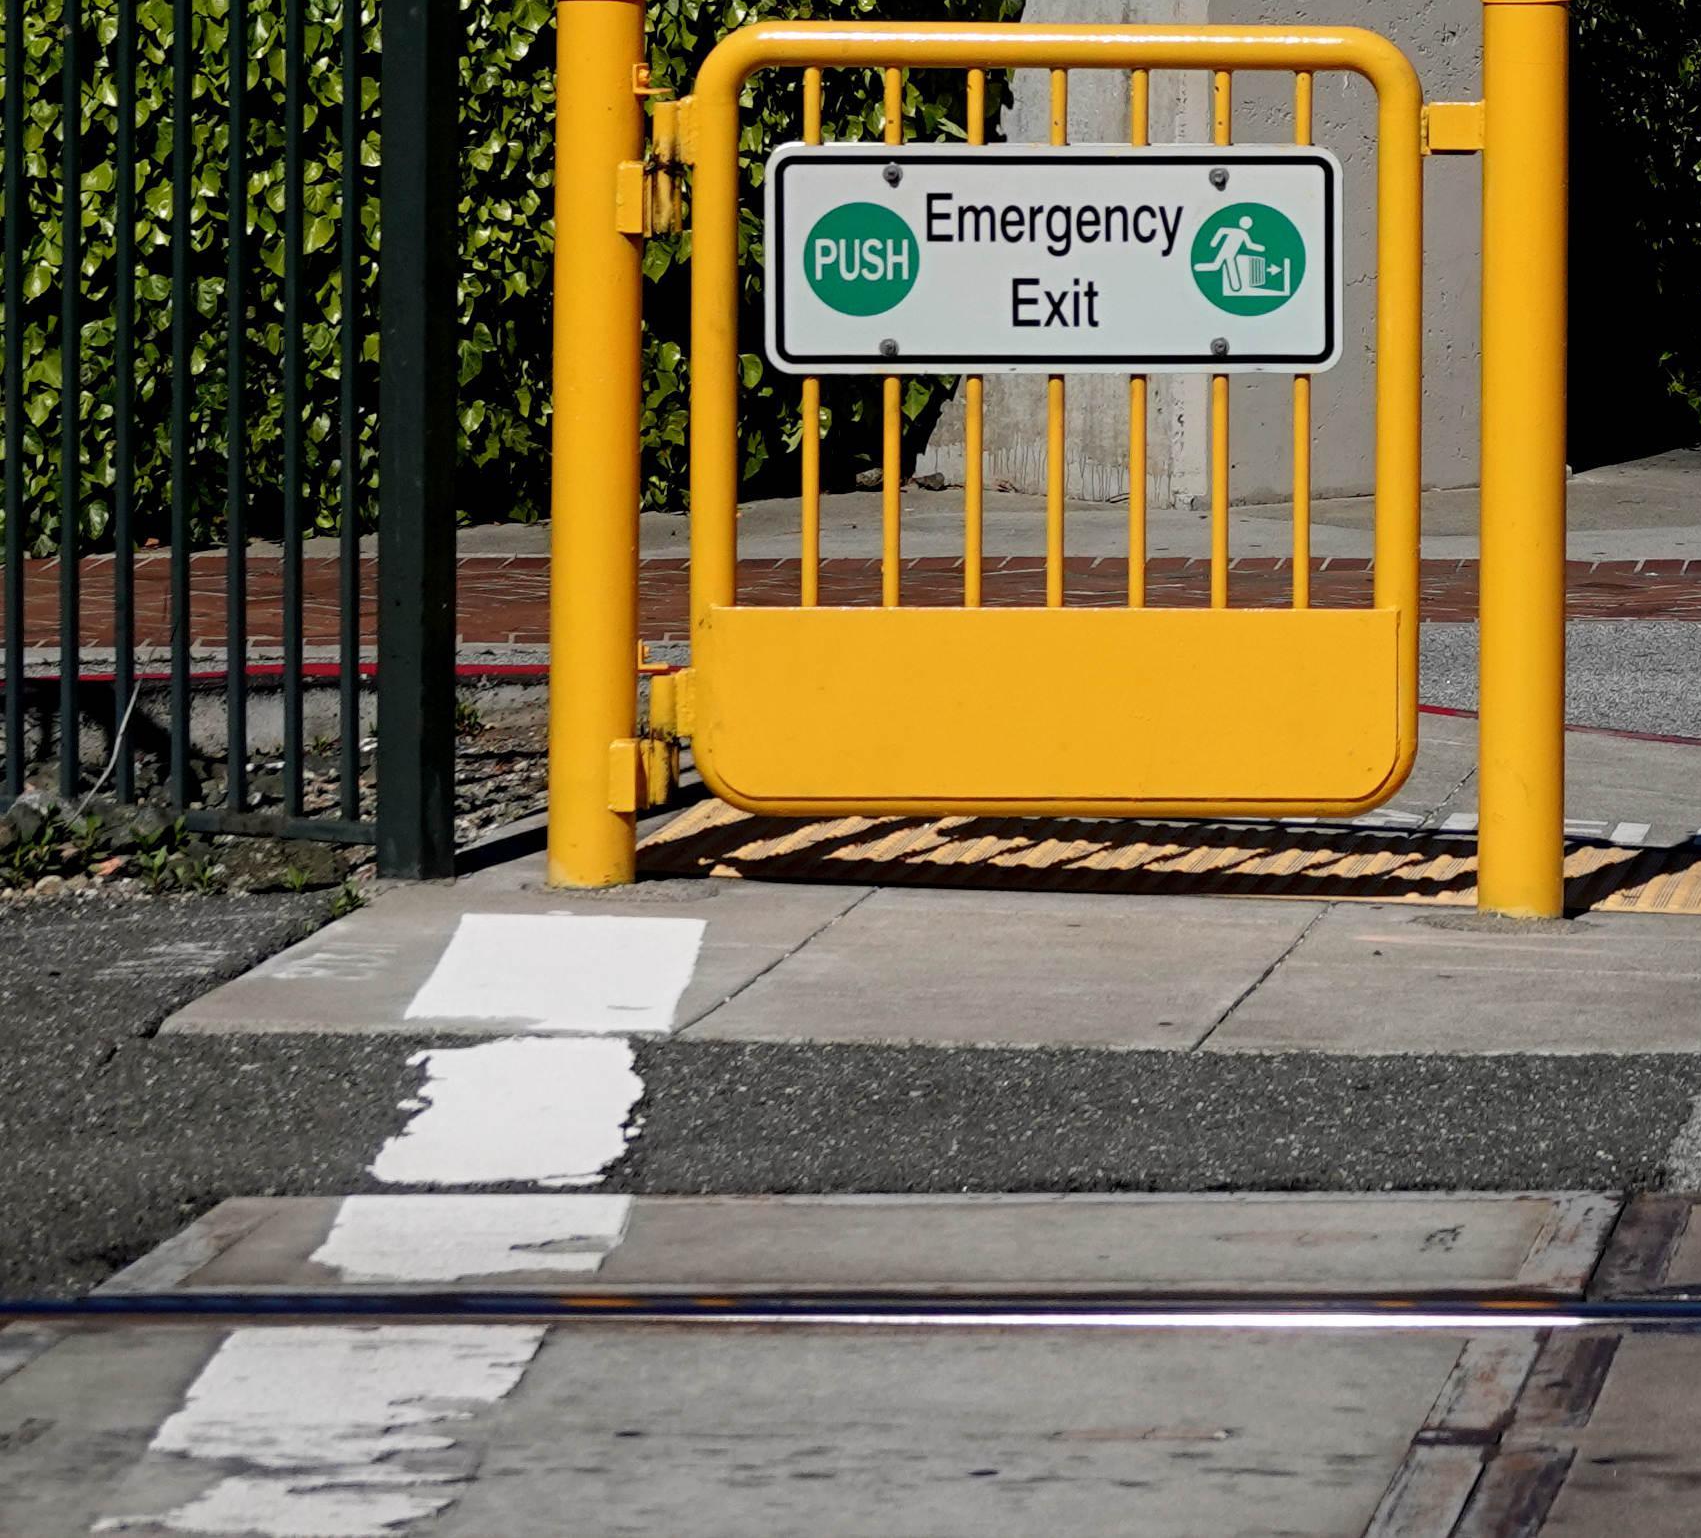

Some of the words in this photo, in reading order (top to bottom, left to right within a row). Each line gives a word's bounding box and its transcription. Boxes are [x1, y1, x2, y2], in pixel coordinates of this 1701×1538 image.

[925, 192, 1184, 257] Emergency
[814, 237, 910, 282] PUSH
[1010, 277, 1100, 328] Exit
